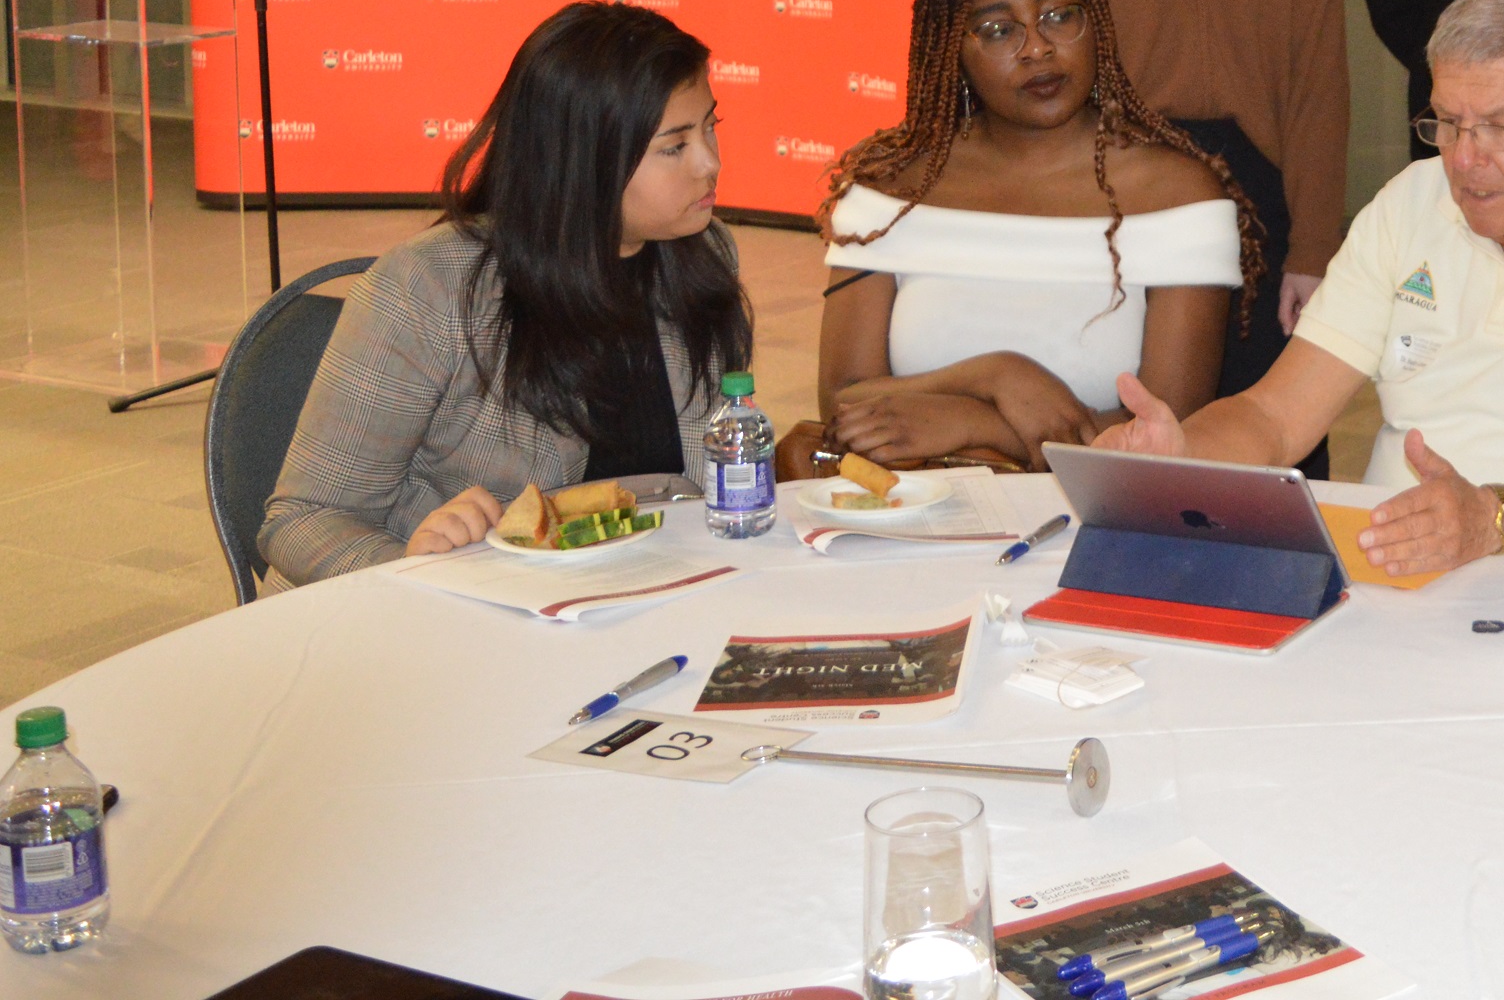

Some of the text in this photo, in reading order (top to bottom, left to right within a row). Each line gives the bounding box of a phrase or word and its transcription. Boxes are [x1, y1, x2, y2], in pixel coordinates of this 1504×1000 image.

[343, 49, 402, 64] Carleton
[713, 60, 760, 77] Carleton
[861, 73, 897, 92] Carleton
[791, 136, 835, 155] Carleton
[753, 660, 924, 677] MED NIGHT
[646, 731, 713, 761] 03
[1036, 868, 1130, 897] Science Student
[1041, 874, 1131, 902] Success Centre
